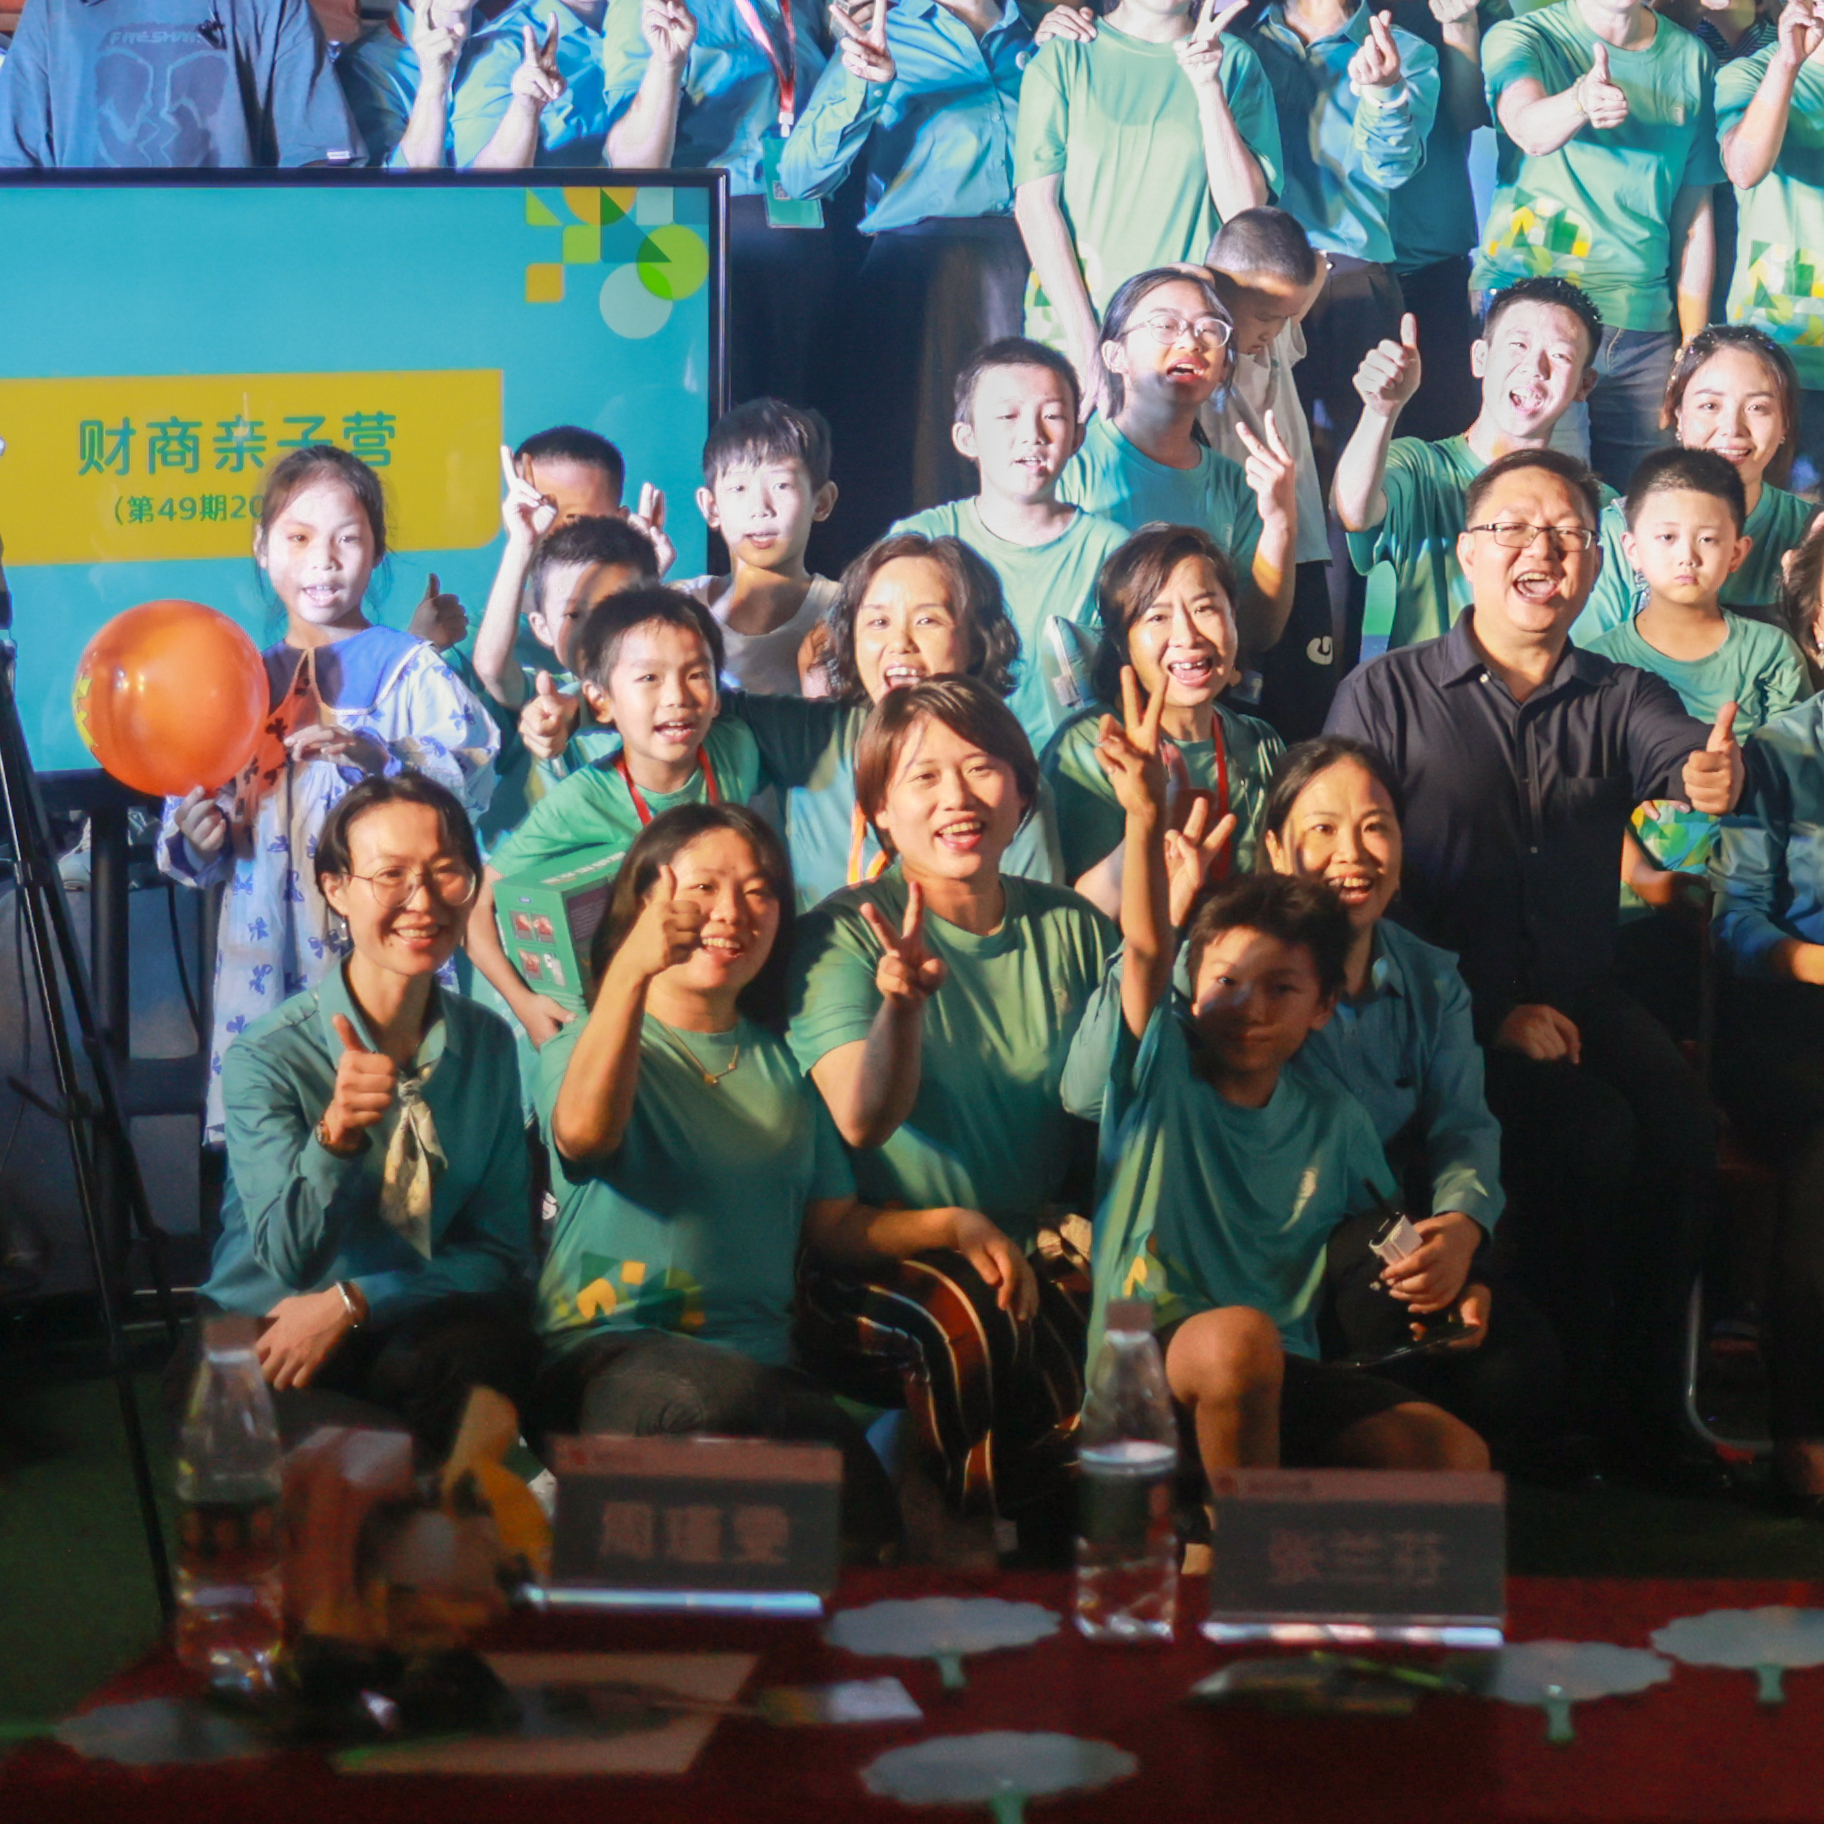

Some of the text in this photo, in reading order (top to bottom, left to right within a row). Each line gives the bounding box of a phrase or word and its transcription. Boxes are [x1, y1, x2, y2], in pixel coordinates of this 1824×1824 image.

[78, 411, 396, 477] 财商亲子营
